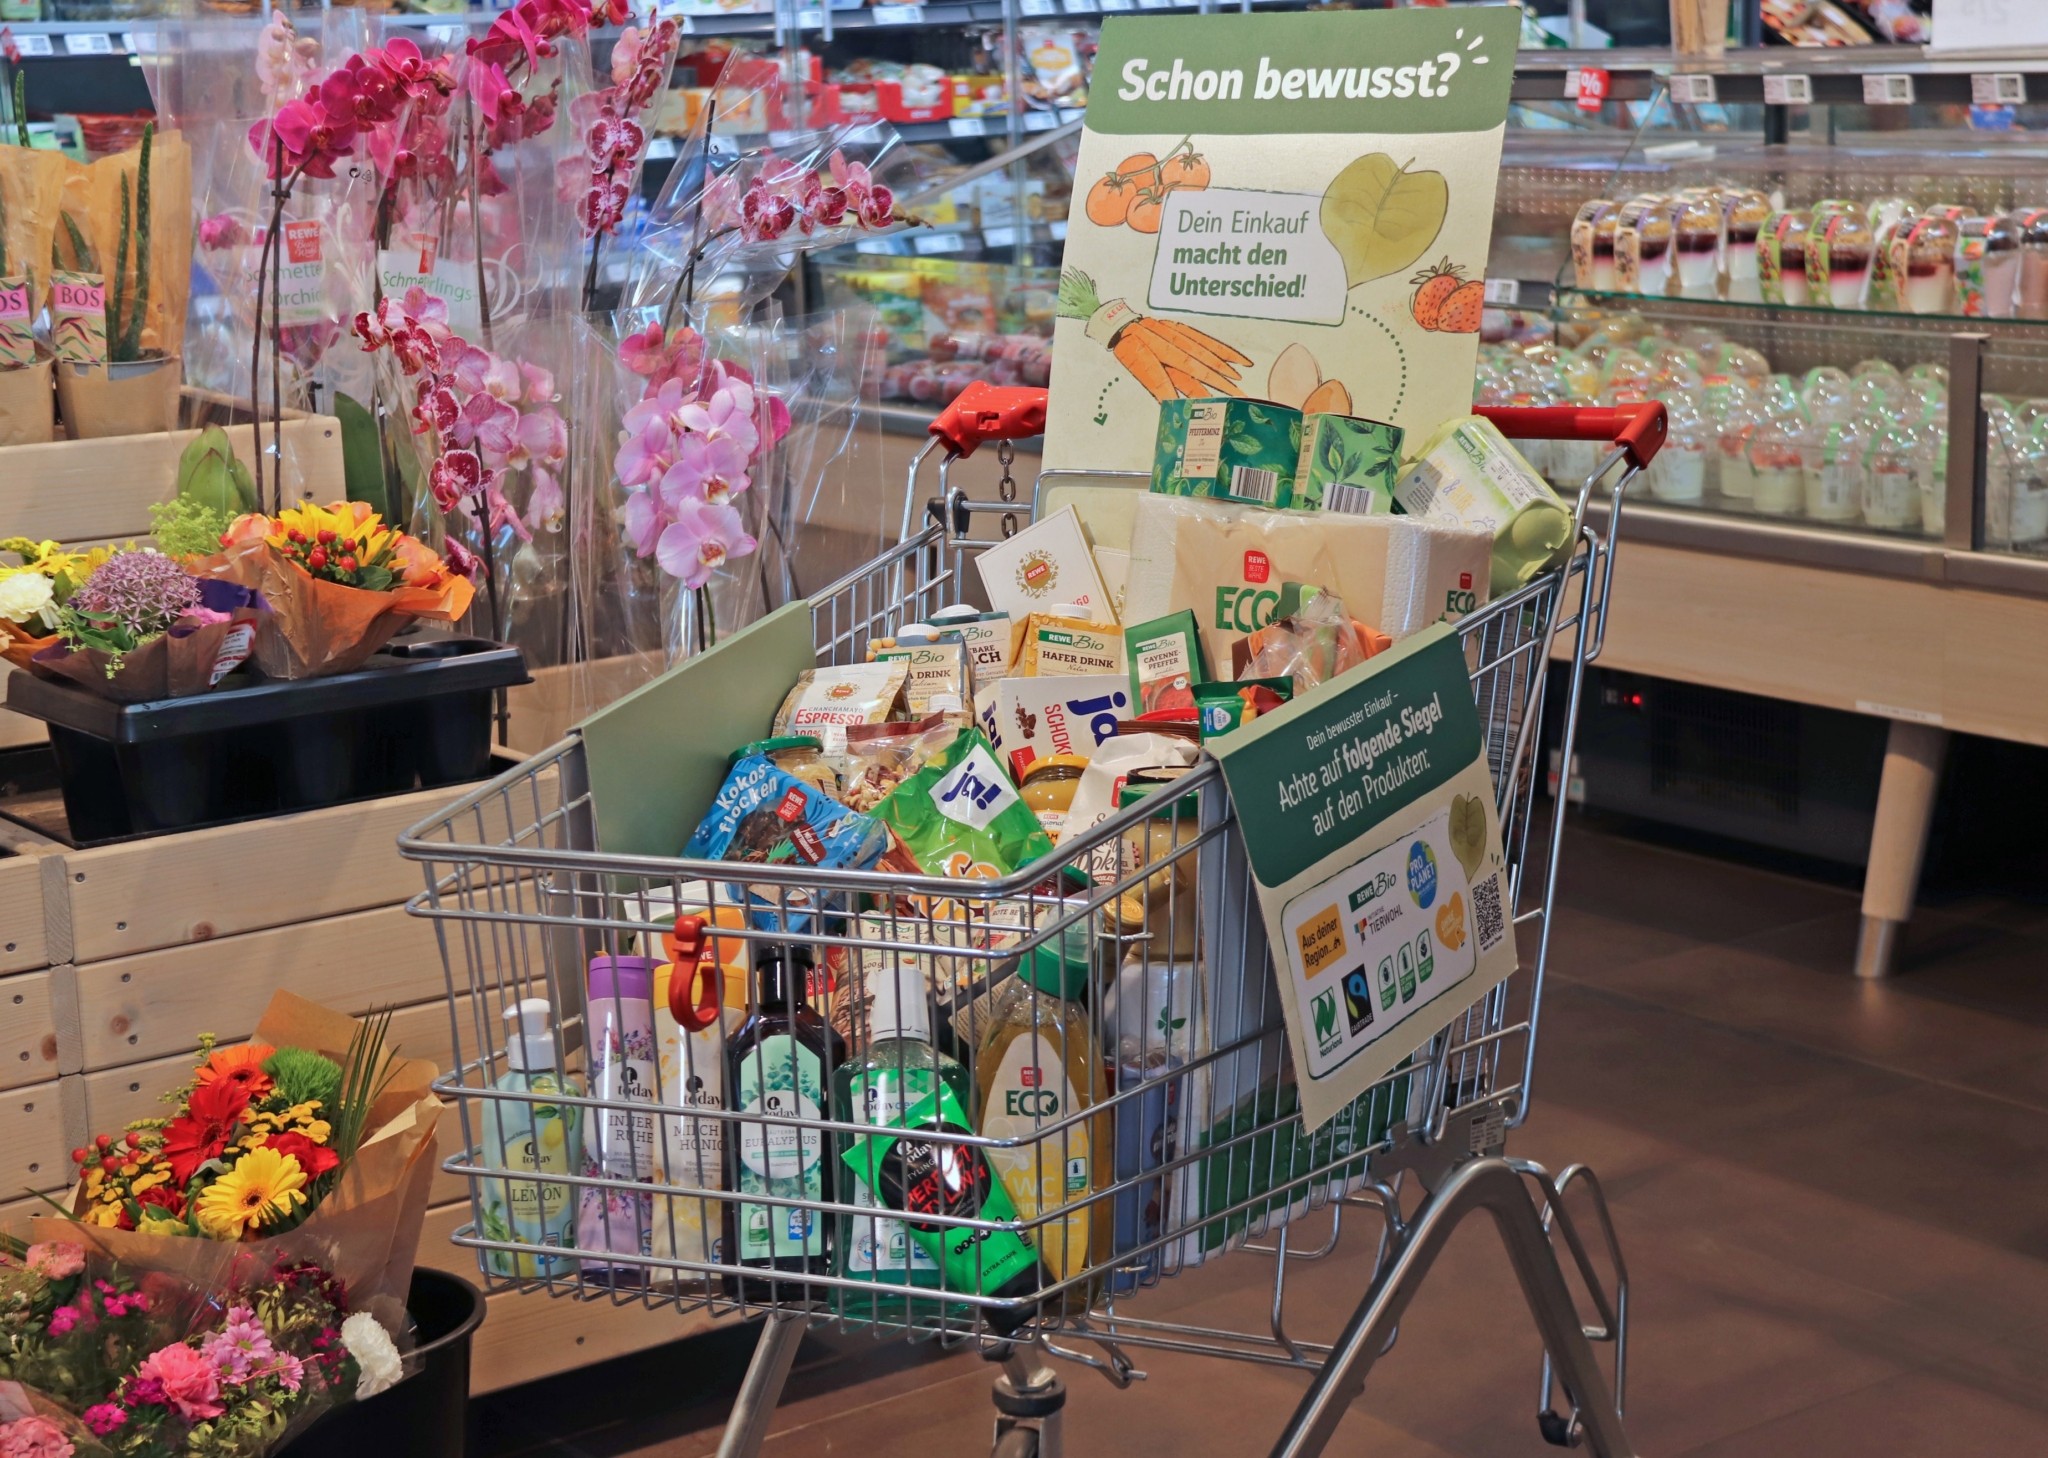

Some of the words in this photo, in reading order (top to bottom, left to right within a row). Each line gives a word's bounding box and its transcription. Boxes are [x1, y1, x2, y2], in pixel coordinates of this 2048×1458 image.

[1117, 58, 1244, 101] Schon
[1253, 52, 1461, 100] bewusst?
[1177, 209, 1222, 233] Dein
[1231, 210, 1310, 234] Einkauf
[1173, 242, 1241, 265] macht
[1247, 242, 1287, 266] den
[61, 286, 100, 308] BOS
[1169, 272, 1307, 298] Unterschied!
[1027, 564, 1047, 580] REWE
[1248, 555, 1267, 565] REWE
[1216, 586, 1280, 634] ECO
[1446, 590, 1476, 615] ECO
[963, 626, 993, 642] Bio
[1048, 633, 1072, 644] REWE
[1073, 634, 1105, 651] Bio
[912, 650, 945, 665] Bio
[1042, 650, 1078, 664] HAFER
[1080, 656, 1115, 669] DRINK
[1143, 649, 1182, 664] CAYENNE-
[1148, 657, 1179, 670] PFEFFER
[917, 669, 951, 679] DRINK
[1306, 731, 1326, 751] Dein
[1326, 709, 1365, 740] bewusster
[1363, 690, 1393, 719] Einkauf
[1277, 769, 1319, 813] Achte
[1320, 749, 1344, 788] auf
[1342, 718, 1403, 774] folgende
[1401, 692, 1444, 739] Siegel
[941, 761, 1002, 811] ja!
[1312, 798, 1336, 837] auf
[1338, 786, 1364, 822] den
[1361, 748, 1431, 805] Produkten:
[719, 776, 777, 833] flocken
[1409, 855, 1424, 877] PRO
[1411, 862, 1435, 892] PLANET
[1356, 885, 1375, 904] REWE
[1375, 872, 1397, 898] Bio
[1369, 904, 1404, 935] TIERWOHL
[1302, 934, 1316, 950] Aus
[1316, 918, 1338, 940] deiner
[1351, 1012, 1373, 1034] FAIRTRADE
[1320, 1035, 1343, 1058] Naturland
[1006, 1090, 1059, 1117] ECO
[522, 1155, 552, 1165] toay
[907, 1158, 936, 1180] TYLING
